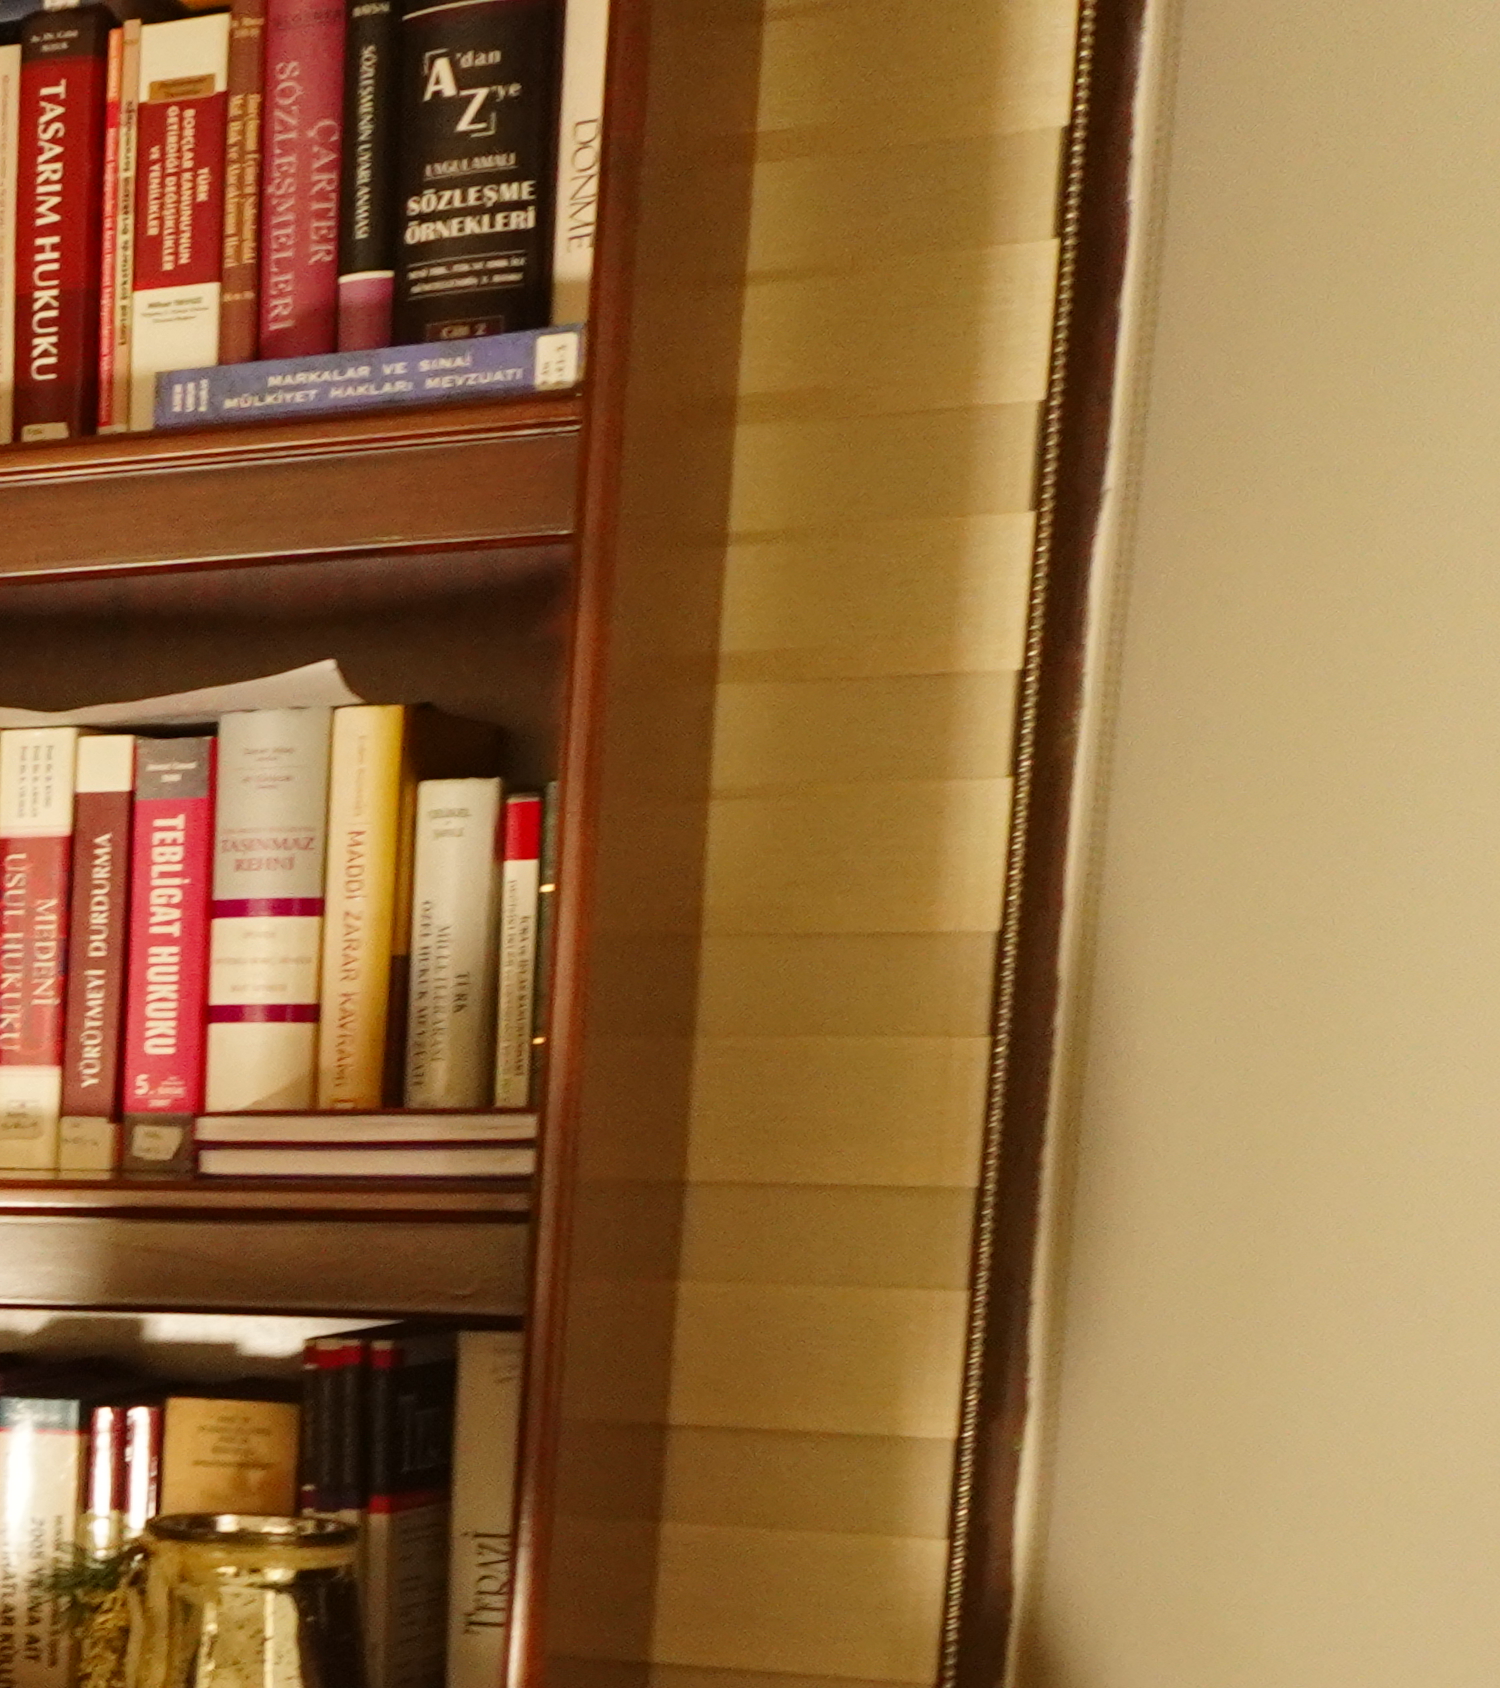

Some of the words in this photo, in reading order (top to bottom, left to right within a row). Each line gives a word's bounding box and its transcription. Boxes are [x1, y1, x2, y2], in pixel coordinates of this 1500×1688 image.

[34, 79, 67, 226] TASARIM
[164, 105, 181, 174] GETİRDİĞİ
[179, 108, 196, 169] BORÇLAR
[195, 167, 212, 203] TÜRK
[305, 119, 340, 266] ÇARTER
[406, 180, 537, 217] SÖZLEŞME
[161, 175, 179, 271] DEĞİŞİKLİKLER
[404, 205, 537, 245] ÖRNEKLERİ
[30, 234, 62, 382] HUKUKU
[223, 386, 318, 410] MÜLKİYET
[424, 367, 524, 390] MEVZUATI
[266, 365, 370, 388] MARKALAR
[381, 361, 409, 376] VE
[3, 853, 28, 925] USUL
[86, 832, 112, 957] DURDURMA
[148, 813, 191, 937] TEBLİGAT
[344, 829, 367, 900] MADDİ
[30, 897, 61, 1006] MEDENİ
[340, 910, 362, 982] ZARAR
[78, 968, 107, 1088] YÜRÜTMEYİ
[143, 945, 180, 1056] HUKUKU
